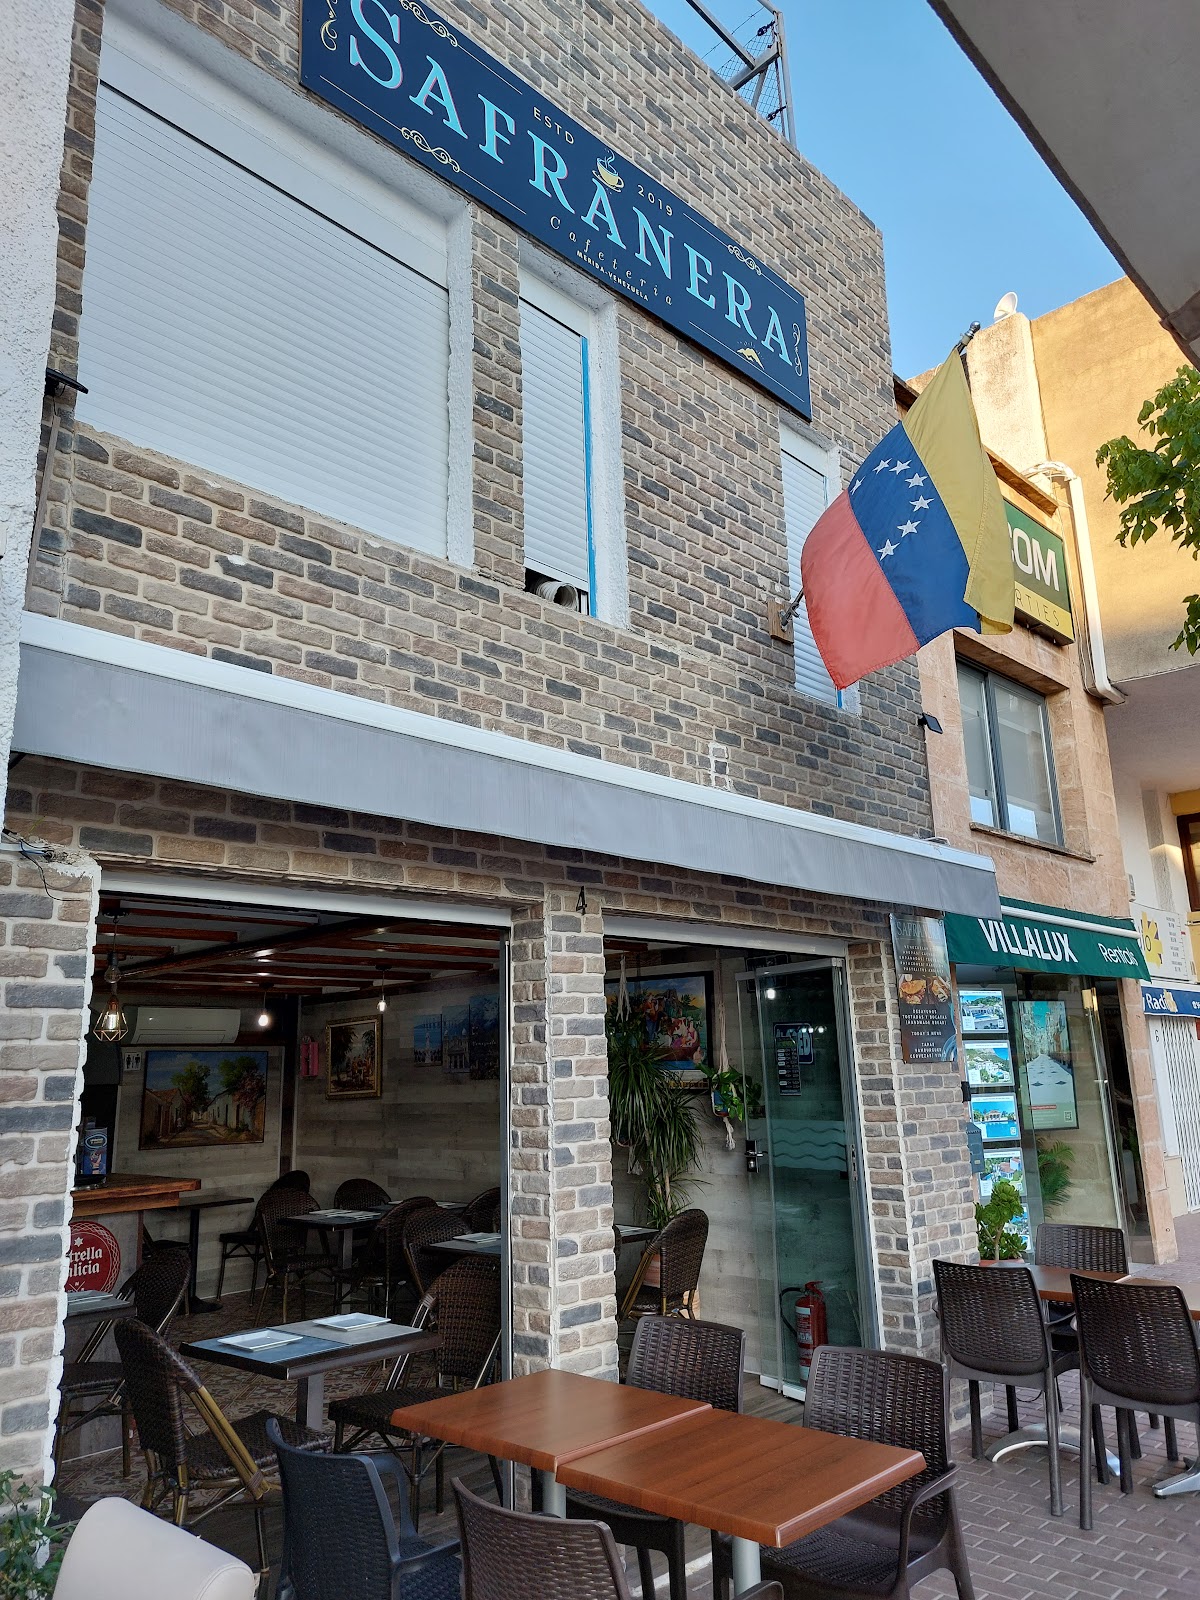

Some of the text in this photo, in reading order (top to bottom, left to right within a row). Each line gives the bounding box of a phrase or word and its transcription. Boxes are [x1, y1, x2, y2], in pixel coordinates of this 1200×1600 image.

[533, 106, 575, 145] ESTD
[350, 0, 793, 367] SAFRANERA
[637, 184, 673, 217] 2019
[550, 215, 673, 306] Cafeteria
[575, 885, 588, 915] 4
[977, 918, 1079, 963] VILLALUX
[1097, 942, 1139, 967] Rentals
[69, 1246, 103, 1263] trella
